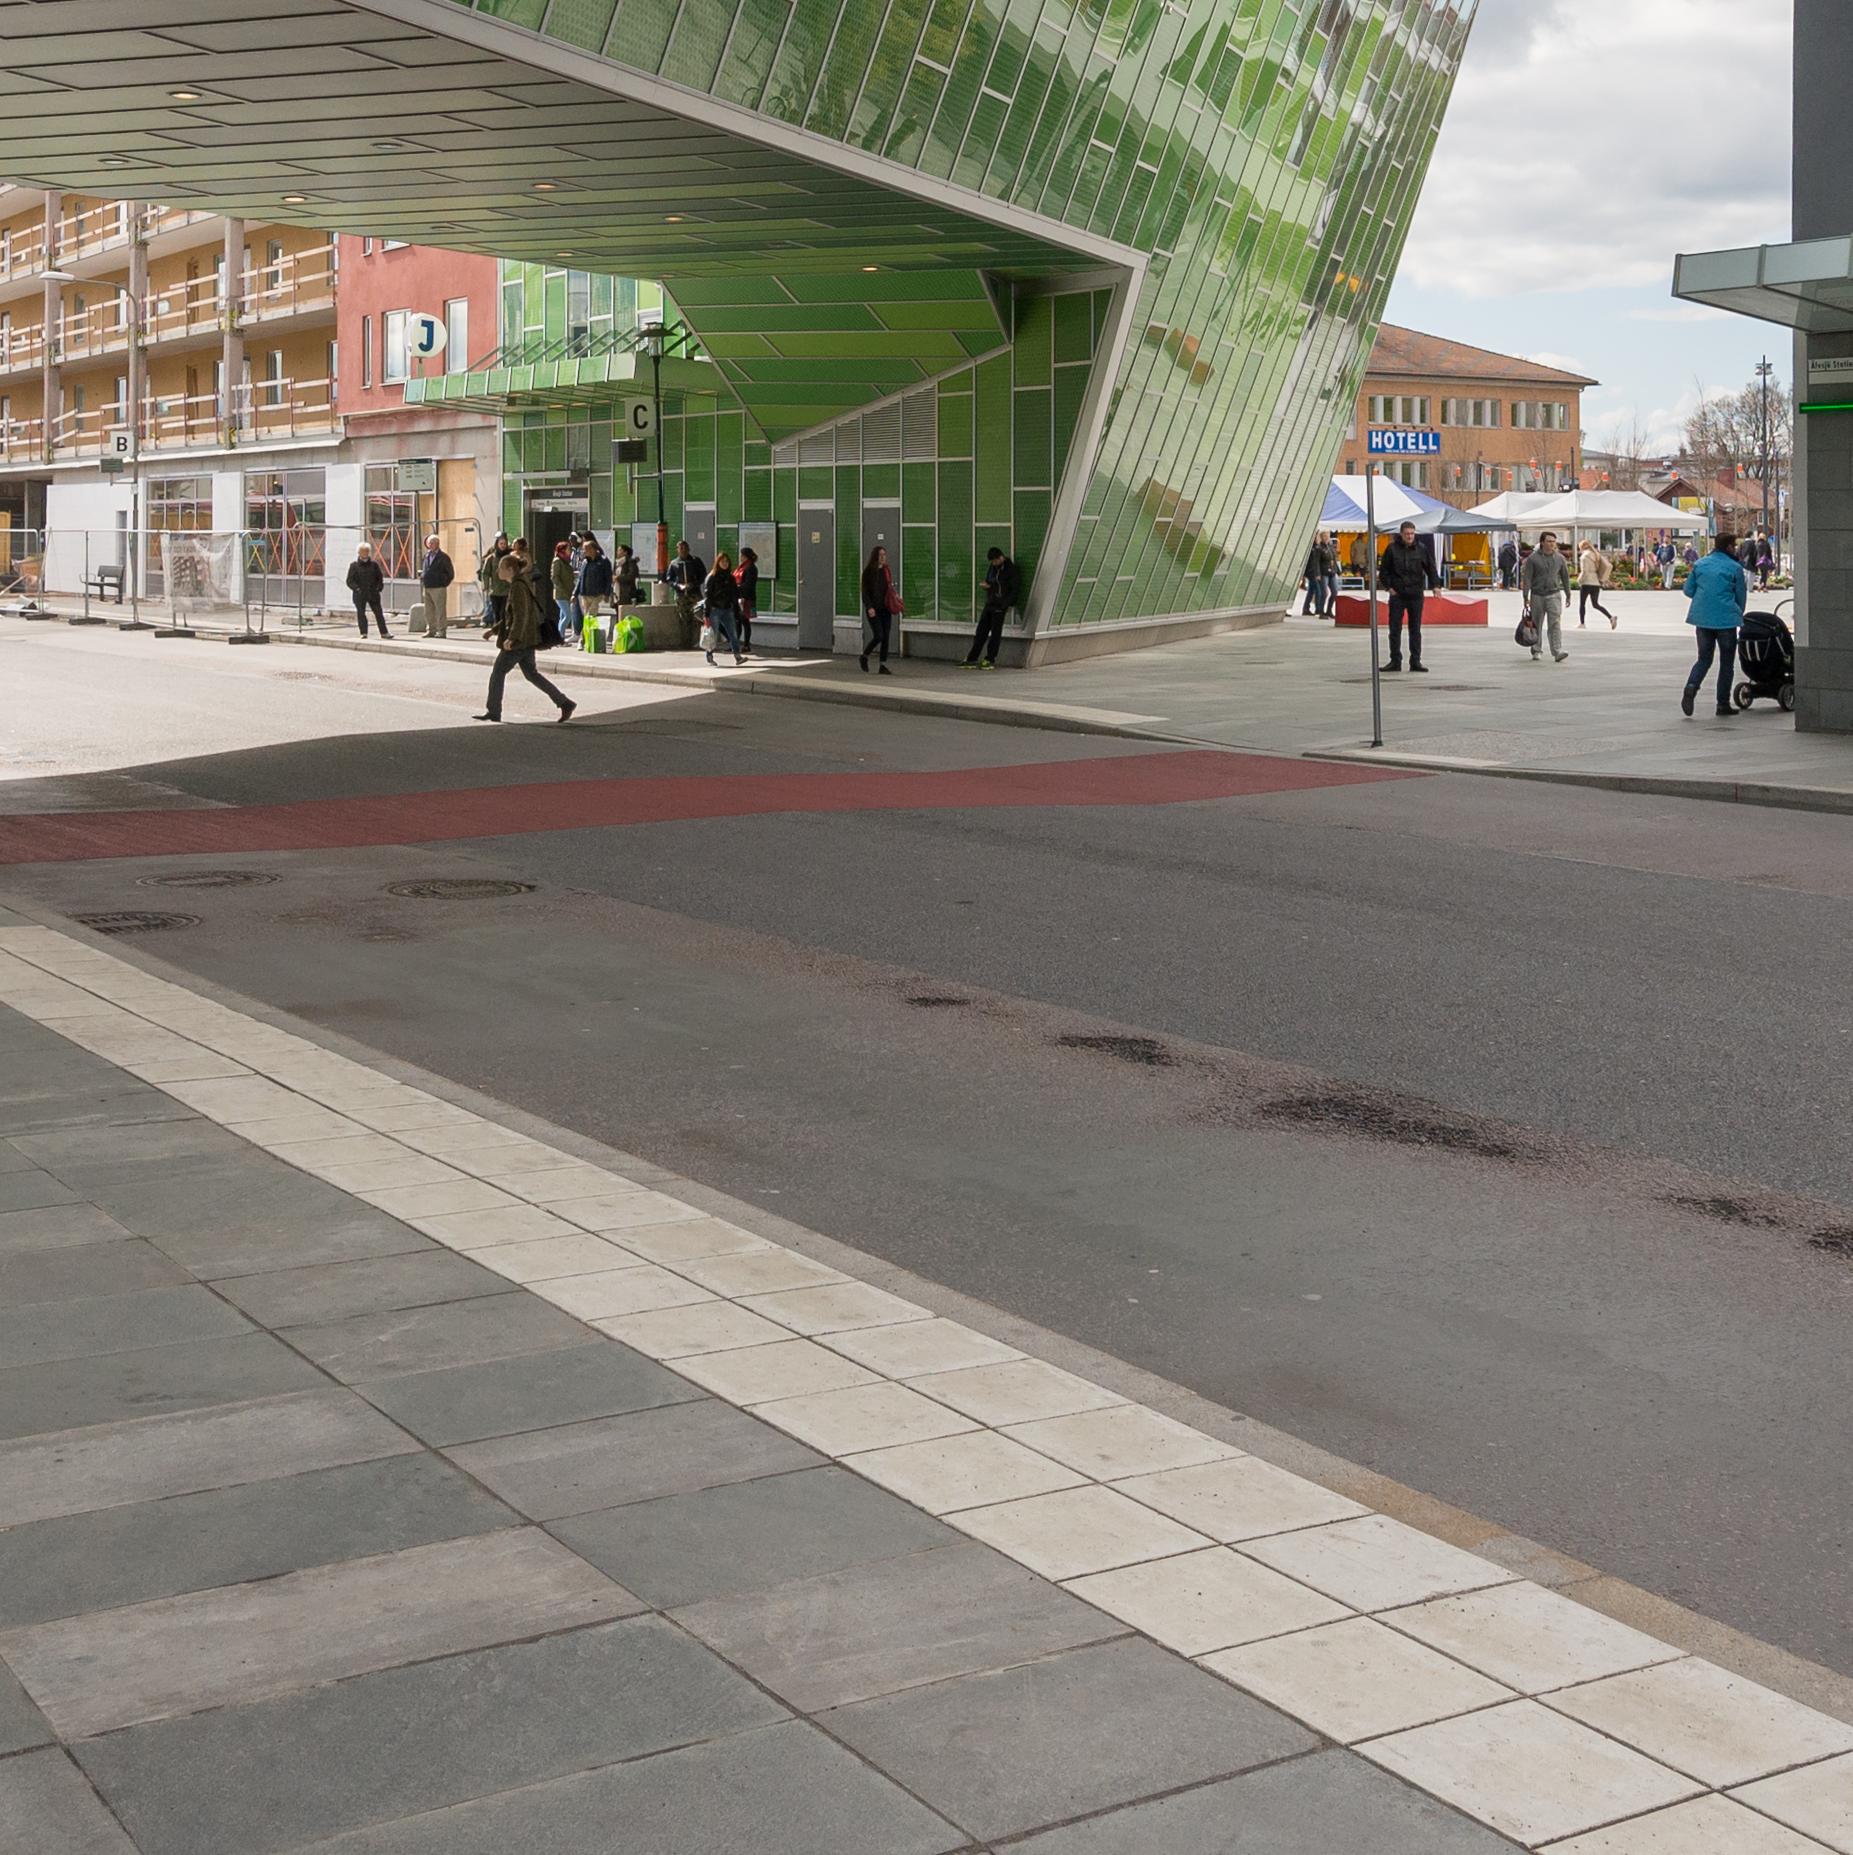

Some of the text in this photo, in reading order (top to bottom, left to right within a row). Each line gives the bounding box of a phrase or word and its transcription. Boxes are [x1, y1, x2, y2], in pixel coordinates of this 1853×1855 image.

[418, 319, 435, 352] J
[633, 404, 649, 430] C
[116, 436, 128, 452] B
[1371, 431, 1438, 451] HOTELL
